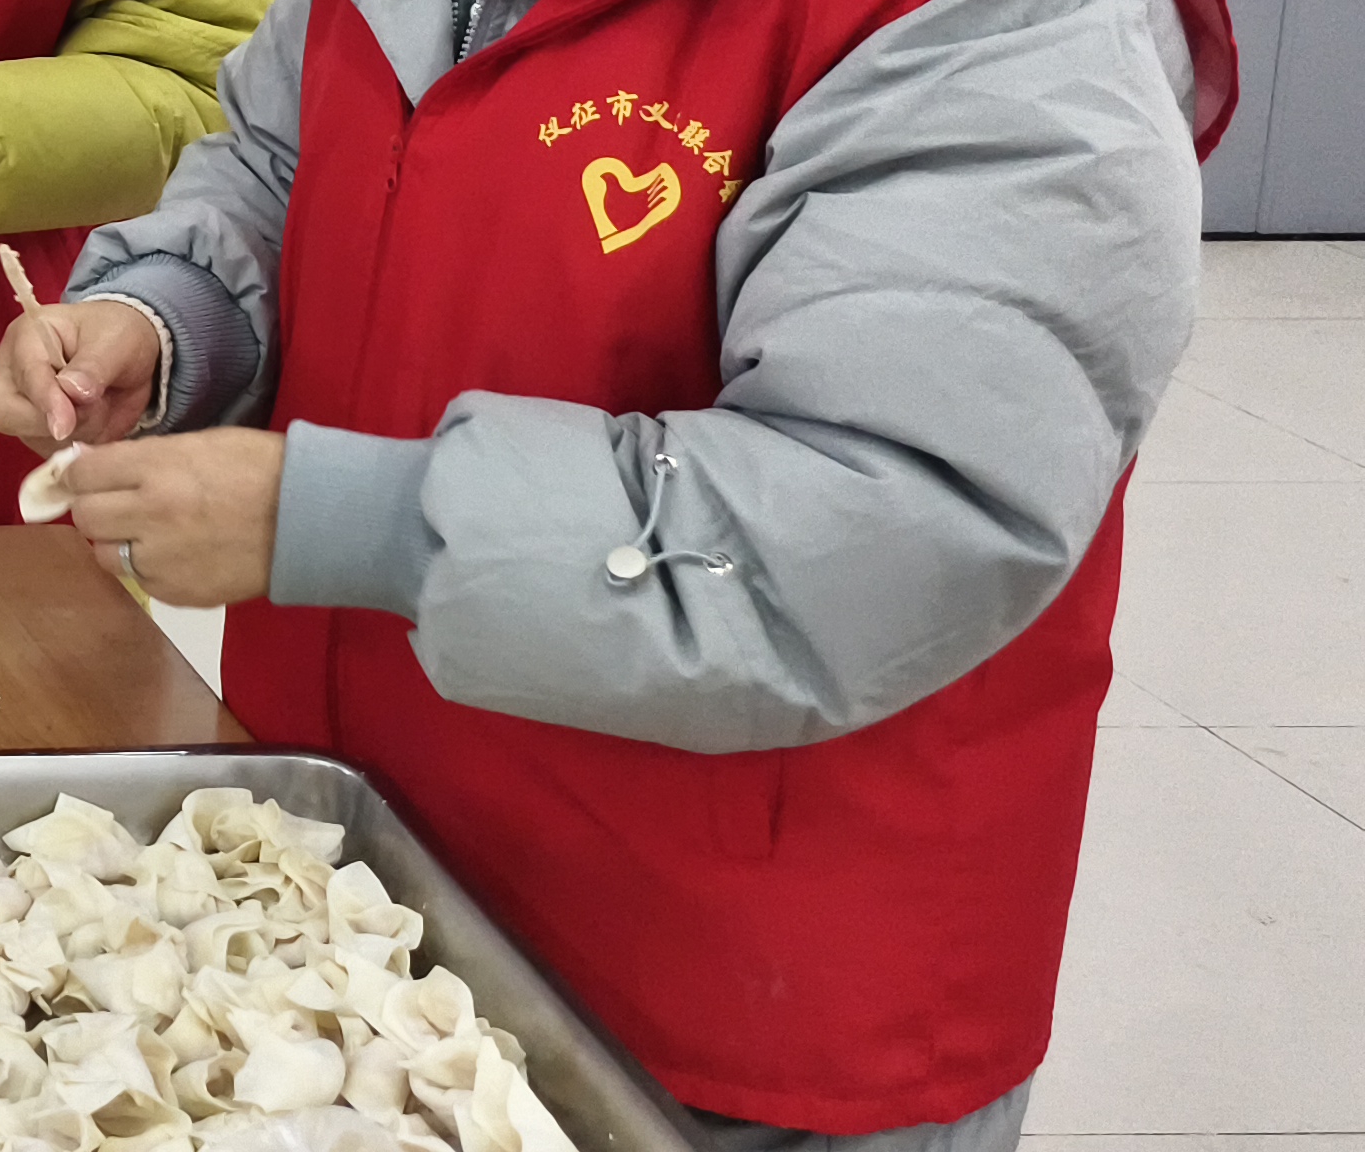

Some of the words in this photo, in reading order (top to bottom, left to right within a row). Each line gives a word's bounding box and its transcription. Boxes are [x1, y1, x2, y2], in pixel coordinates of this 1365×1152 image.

[538, 90, 744, 204] 仪征市义联合会
